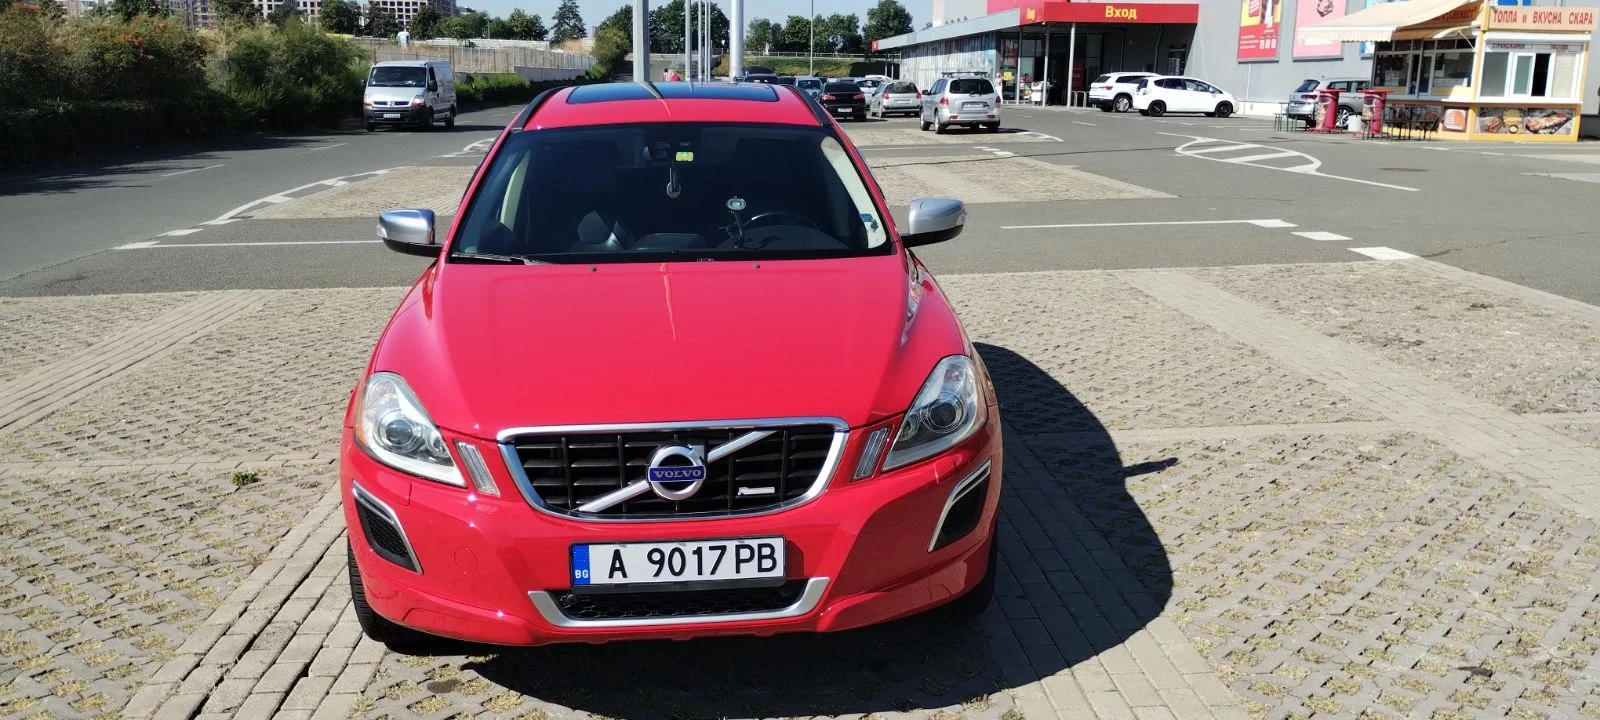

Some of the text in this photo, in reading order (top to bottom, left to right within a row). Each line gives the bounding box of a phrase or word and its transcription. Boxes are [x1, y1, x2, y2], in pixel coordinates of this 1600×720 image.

[1105, 6, 1137, 19] Вход
[1493, 10, 1517, 23] ТОПЛА
[1533, 11, 1562, 24] ВКУСНА
[1568, 12, 1593, 25] СКАРА
[653, 469, 701, 478] VOLVO
[608, 548, 628, 578] A
[574, 569, 589, 579] BG
